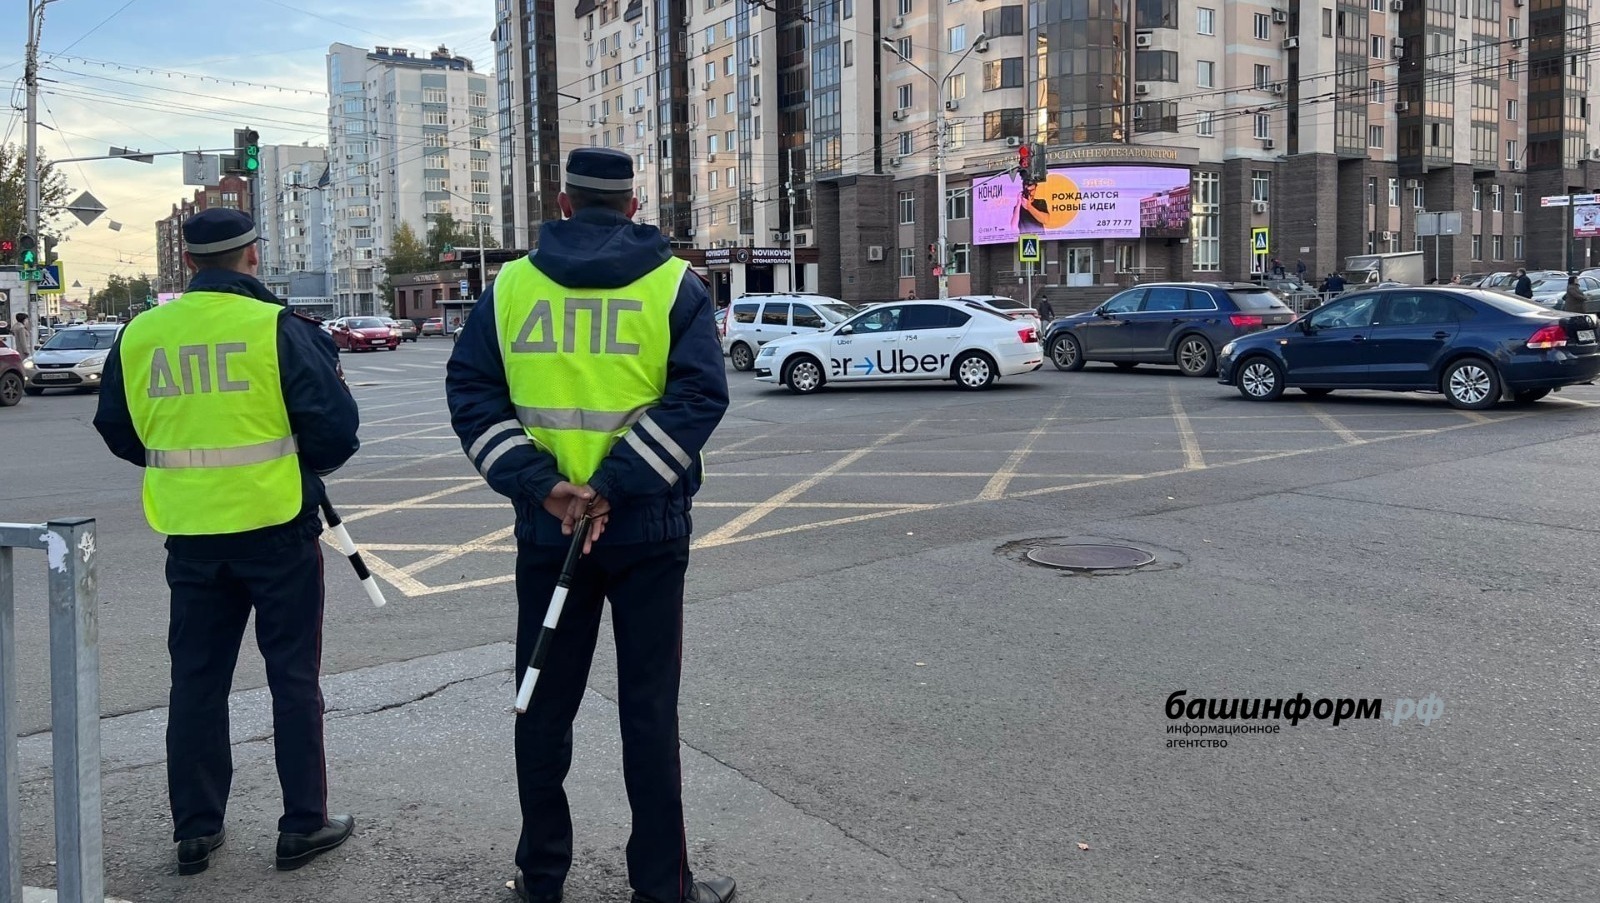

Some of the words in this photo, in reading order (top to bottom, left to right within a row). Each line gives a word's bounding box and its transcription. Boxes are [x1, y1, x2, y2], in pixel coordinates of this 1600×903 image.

[1051, 191, 1119, 201] РОЖДАЮТСЯ
[1051, 203, 1087, 212] НОВЫЕ
[1089, 202, 1116, 211] ИДЕИ
[1096, 219, 1111, 227] 287
[510, 297, 643, 355] ДПС
[147, 342, 249, 398] ДПС
[877, 349, 950, 374] Uber
